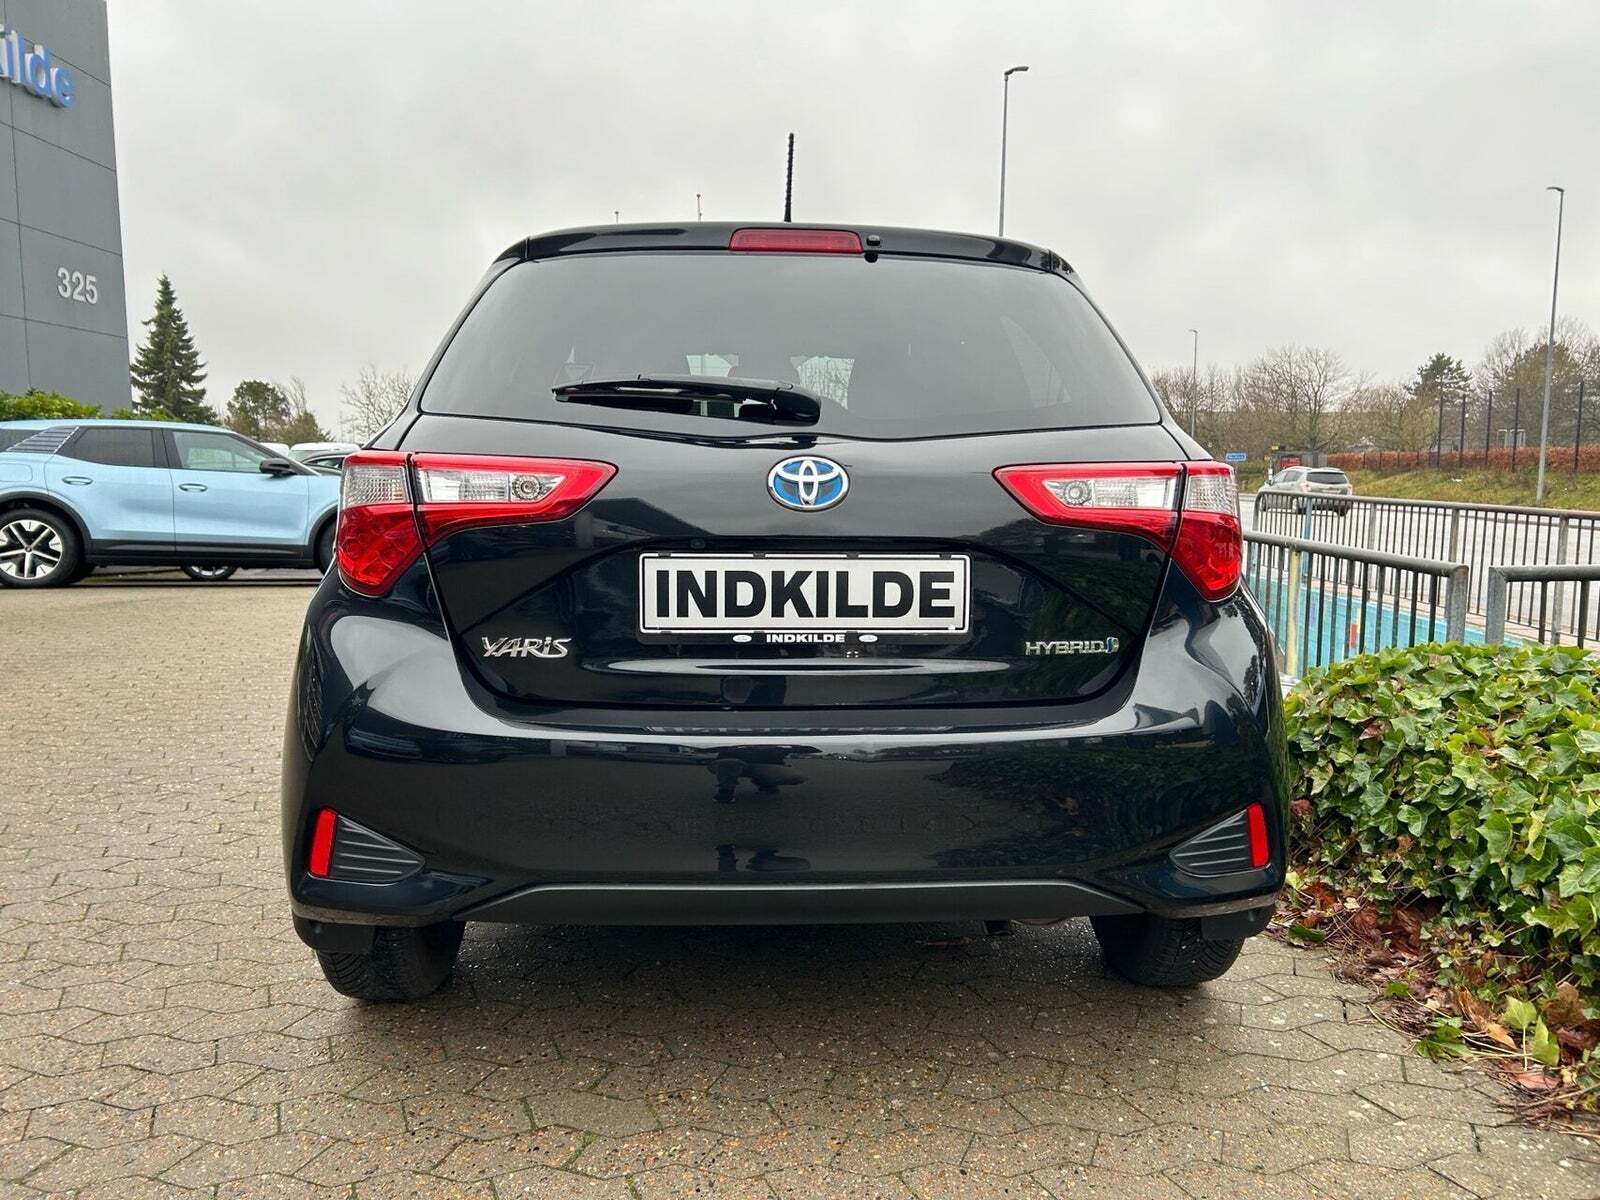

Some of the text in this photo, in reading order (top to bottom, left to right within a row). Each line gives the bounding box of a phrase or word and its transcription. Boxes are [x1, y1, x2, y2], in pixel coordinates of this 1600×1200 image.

[0, 21, 76, 108] ilde
[57, 267, 98, 304] 325
[656, 570, 956, 619] INDKILDE
[766, 633, 846, 643] INDKILDE
[1025, 640, 1105, 655] HYBRID
